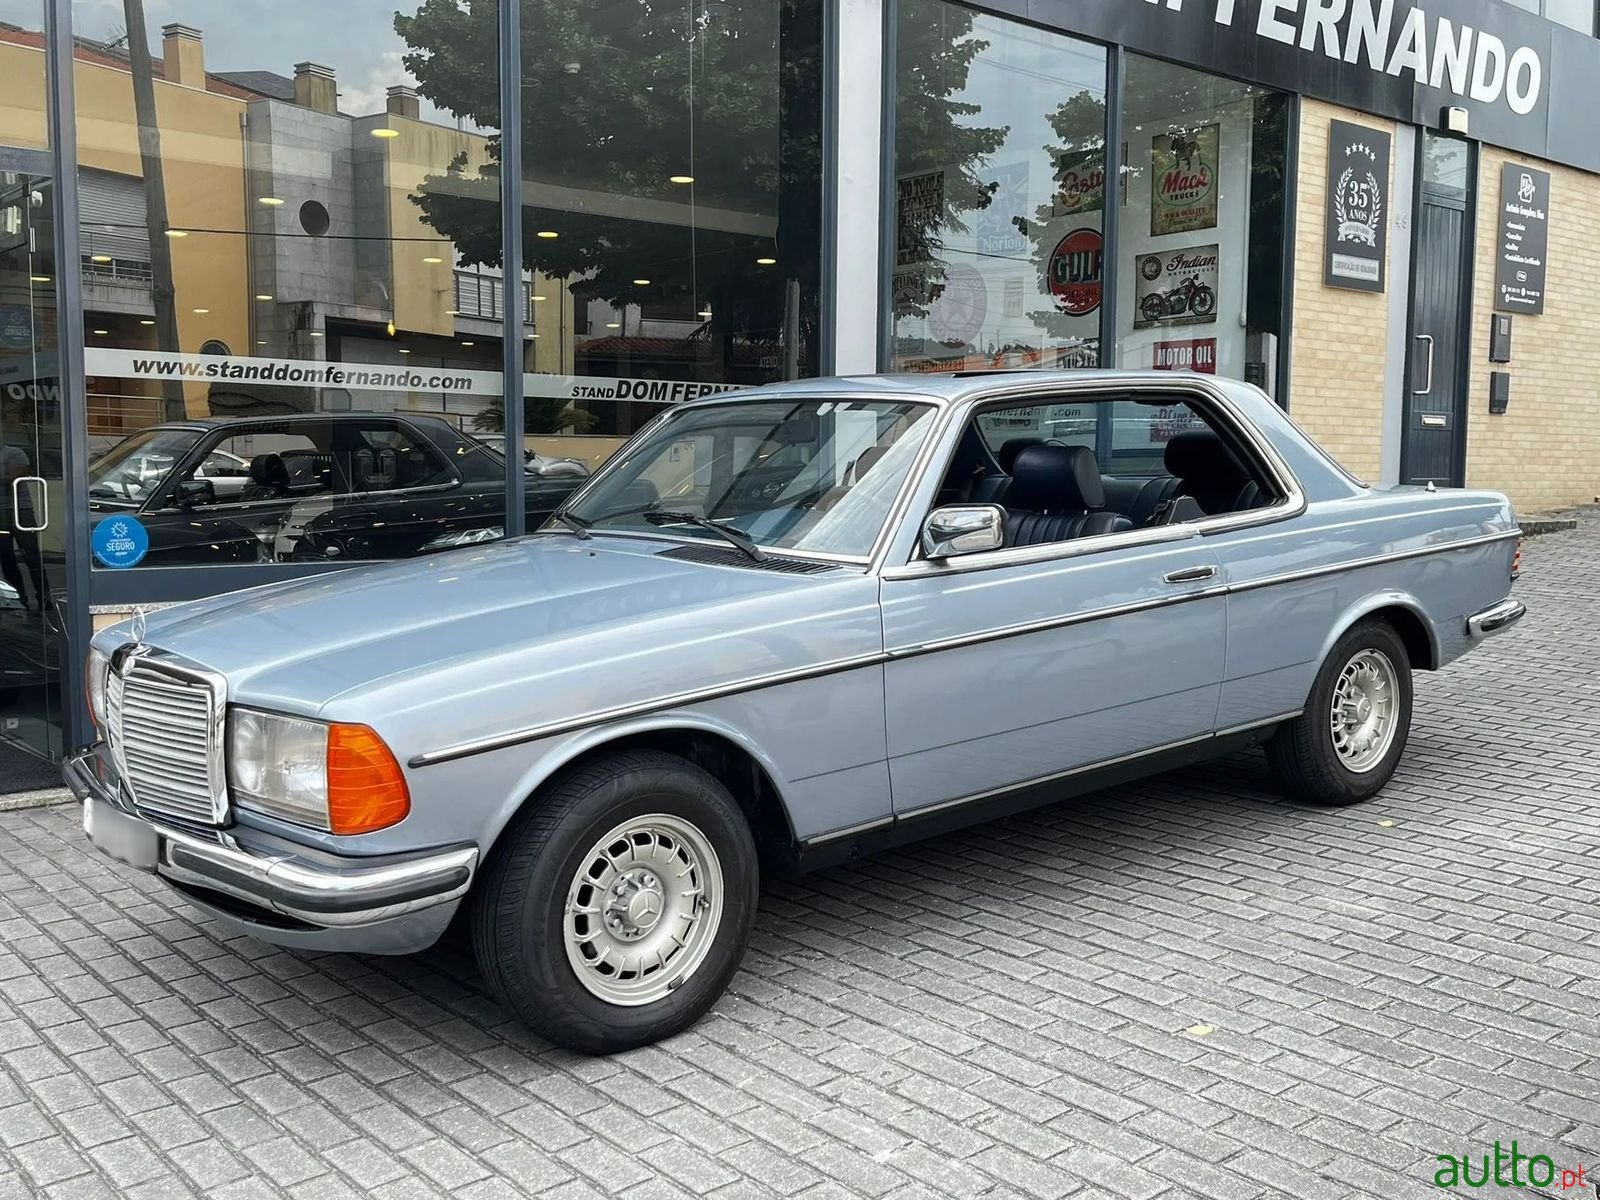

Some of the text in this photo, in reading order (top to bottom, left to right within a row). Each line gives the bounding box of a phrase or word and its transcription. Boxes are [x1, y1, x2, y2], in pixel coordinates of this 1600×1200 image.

[1161, 167, 1208, 194] Mack
[1169, 190, 1199, 201] TRUCKS
[1348, 180, 1369, 208] 35
[1348, 208, 1368, 221] ANOS
[984, 235, 1025, 252] Norton
[1166, 254, 1216, 271] Indian
[1157, 346, 1212, 367] MOTOR OIL
[132, 358, 473, 390] www.standdomfernando.com
[571, 386, 614, 399] STAND
[106, 541, 135, 552] SEGURO
